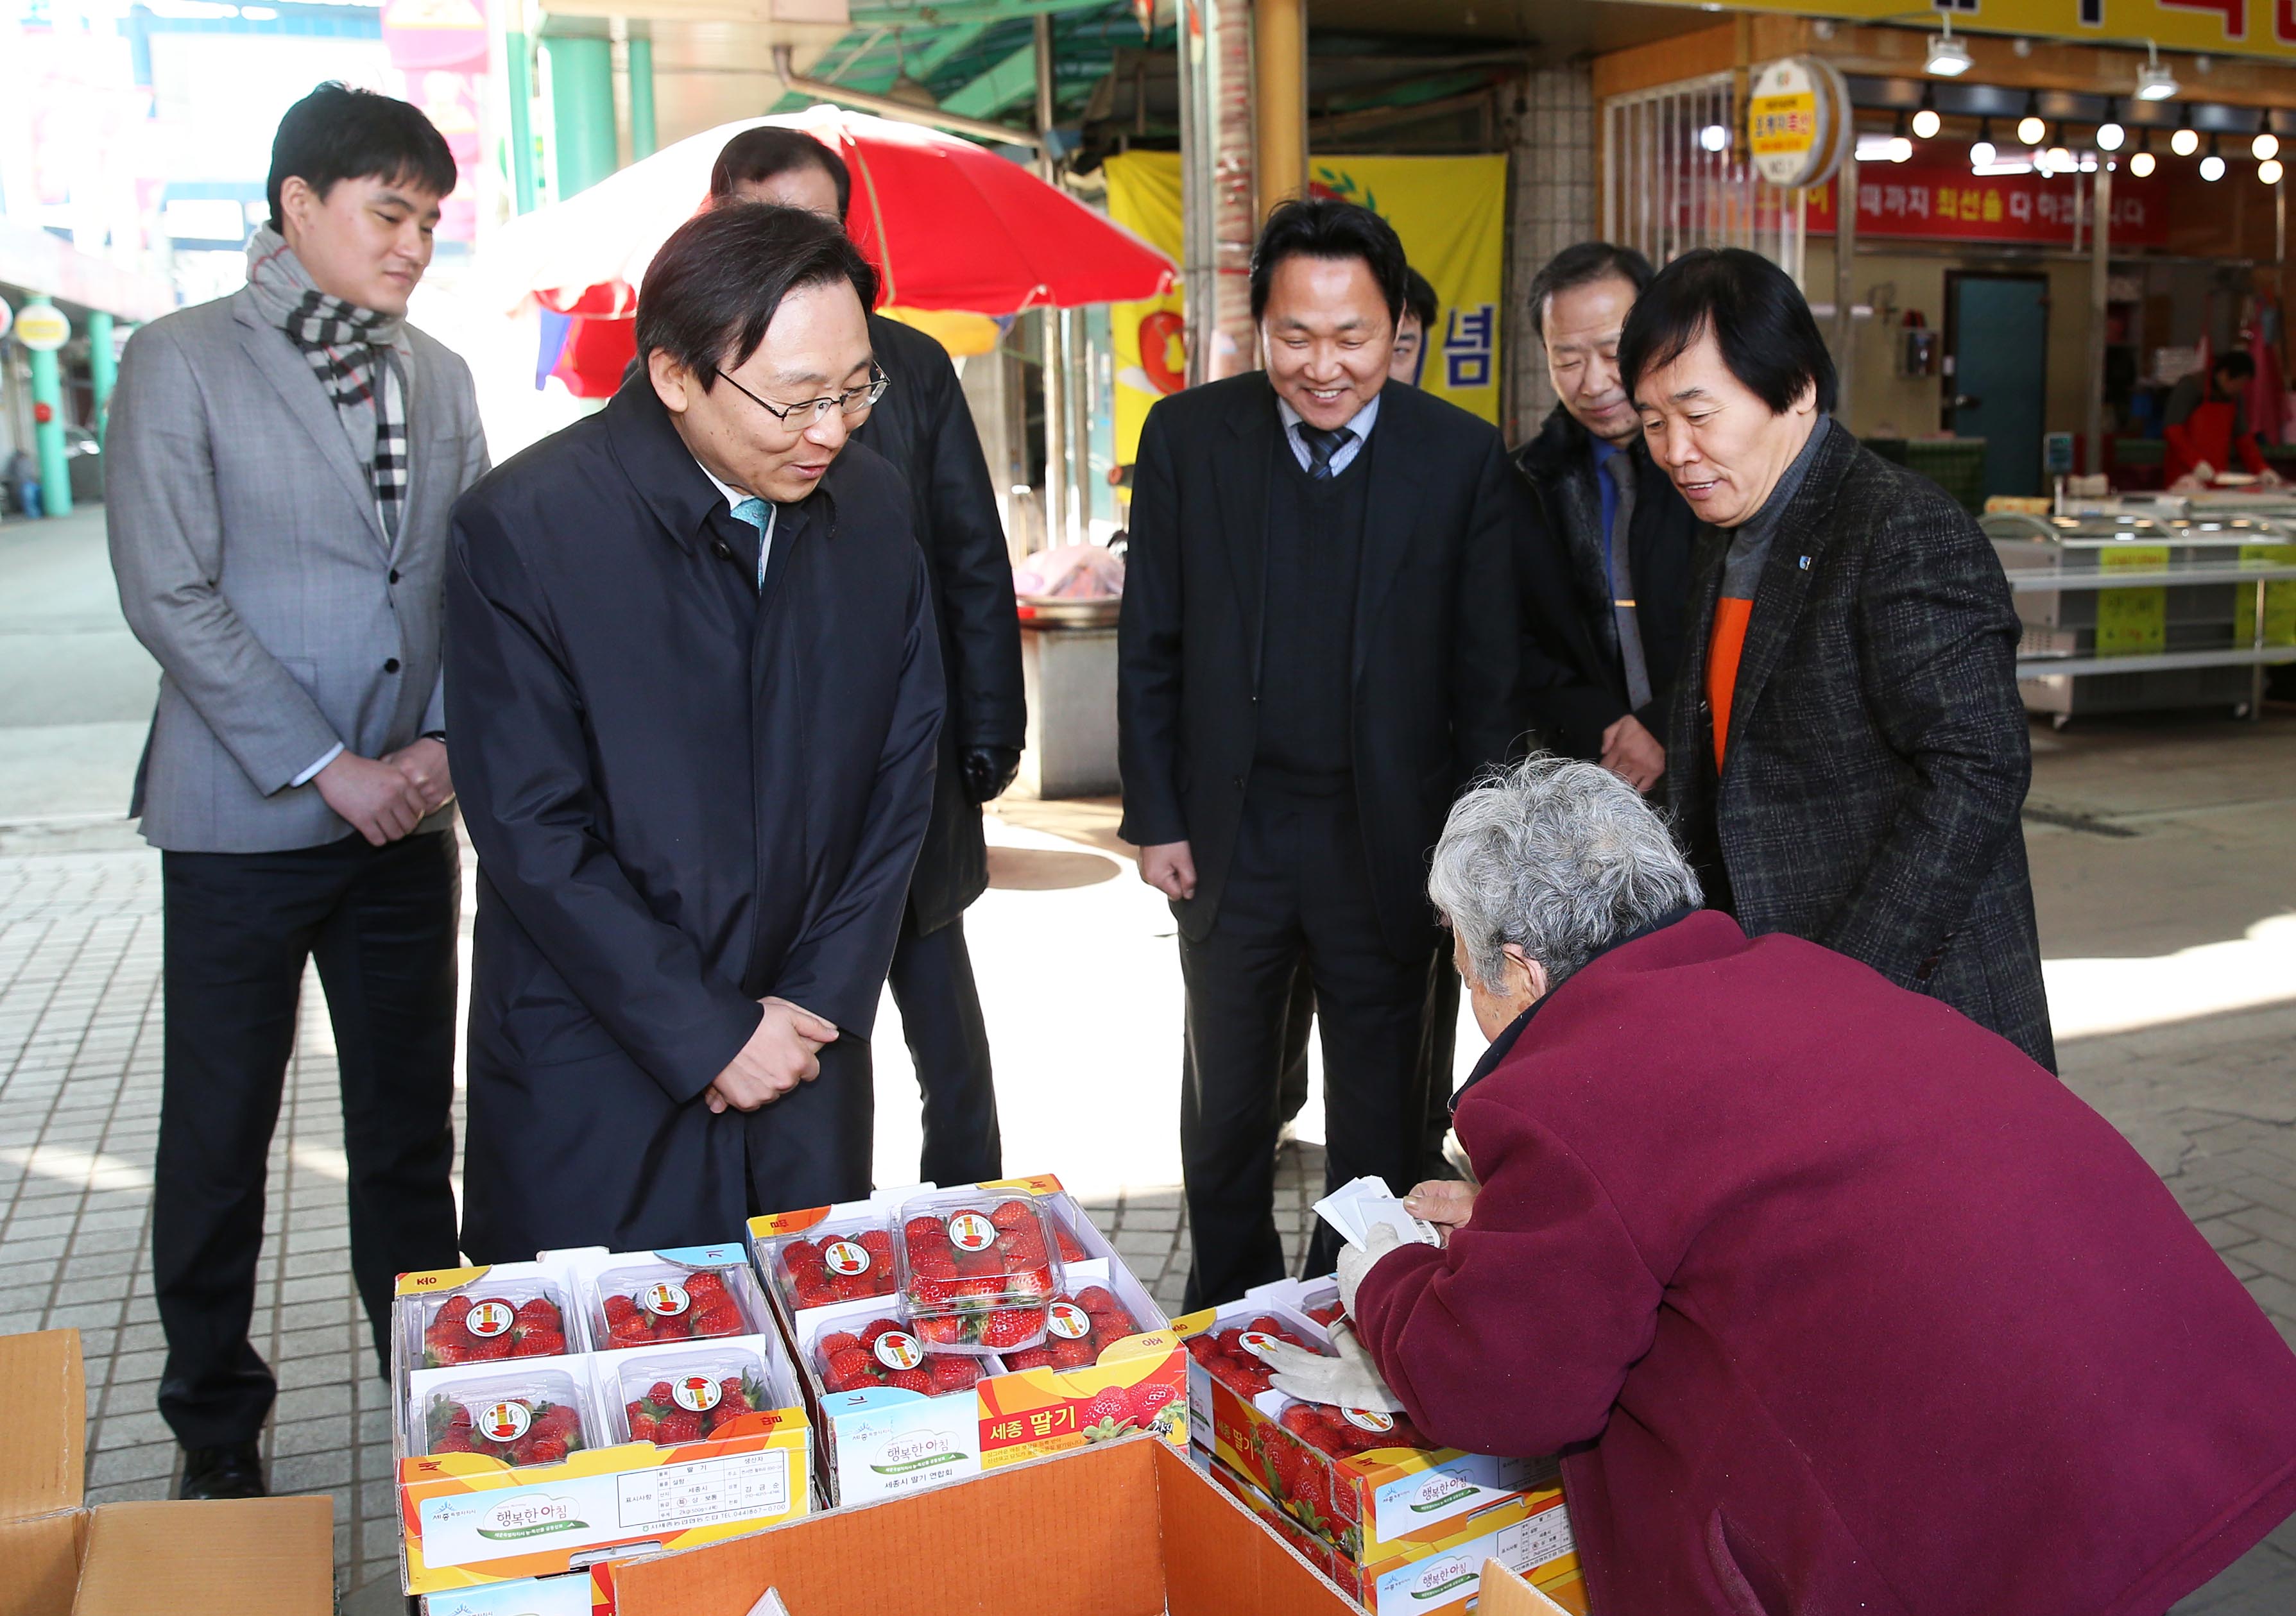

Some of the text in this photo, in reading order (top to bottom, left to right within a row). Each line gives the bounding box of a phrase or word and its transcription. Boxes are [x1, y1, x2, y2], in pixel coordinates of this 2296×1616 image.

[1937, 187, 2003, 222] 최선을
[990, 1405, 1075, 1440] 세종 딸기
[1150, 1418, 1173, 1433] 2kg
[887, 1443, 924, 1462] 행복한
[925, 1439, 949, 1452] 아침
[1233, 1428, 1255, 1461] 딸기
[744, 1456, 764, 1464] 생산자
[884, 1468, 953, 1489] 세종시 딸기 연합회
[1423, 1476, 1467, 1501] 행복한 아침
[626, 1494, 652, 1503] 표시사항
[497, 1504, 567, 1527] 행복한 아침
[1423, 1569, 1449, 1588] 행복한
[1450, 1562, 1466, 1574] 아침
